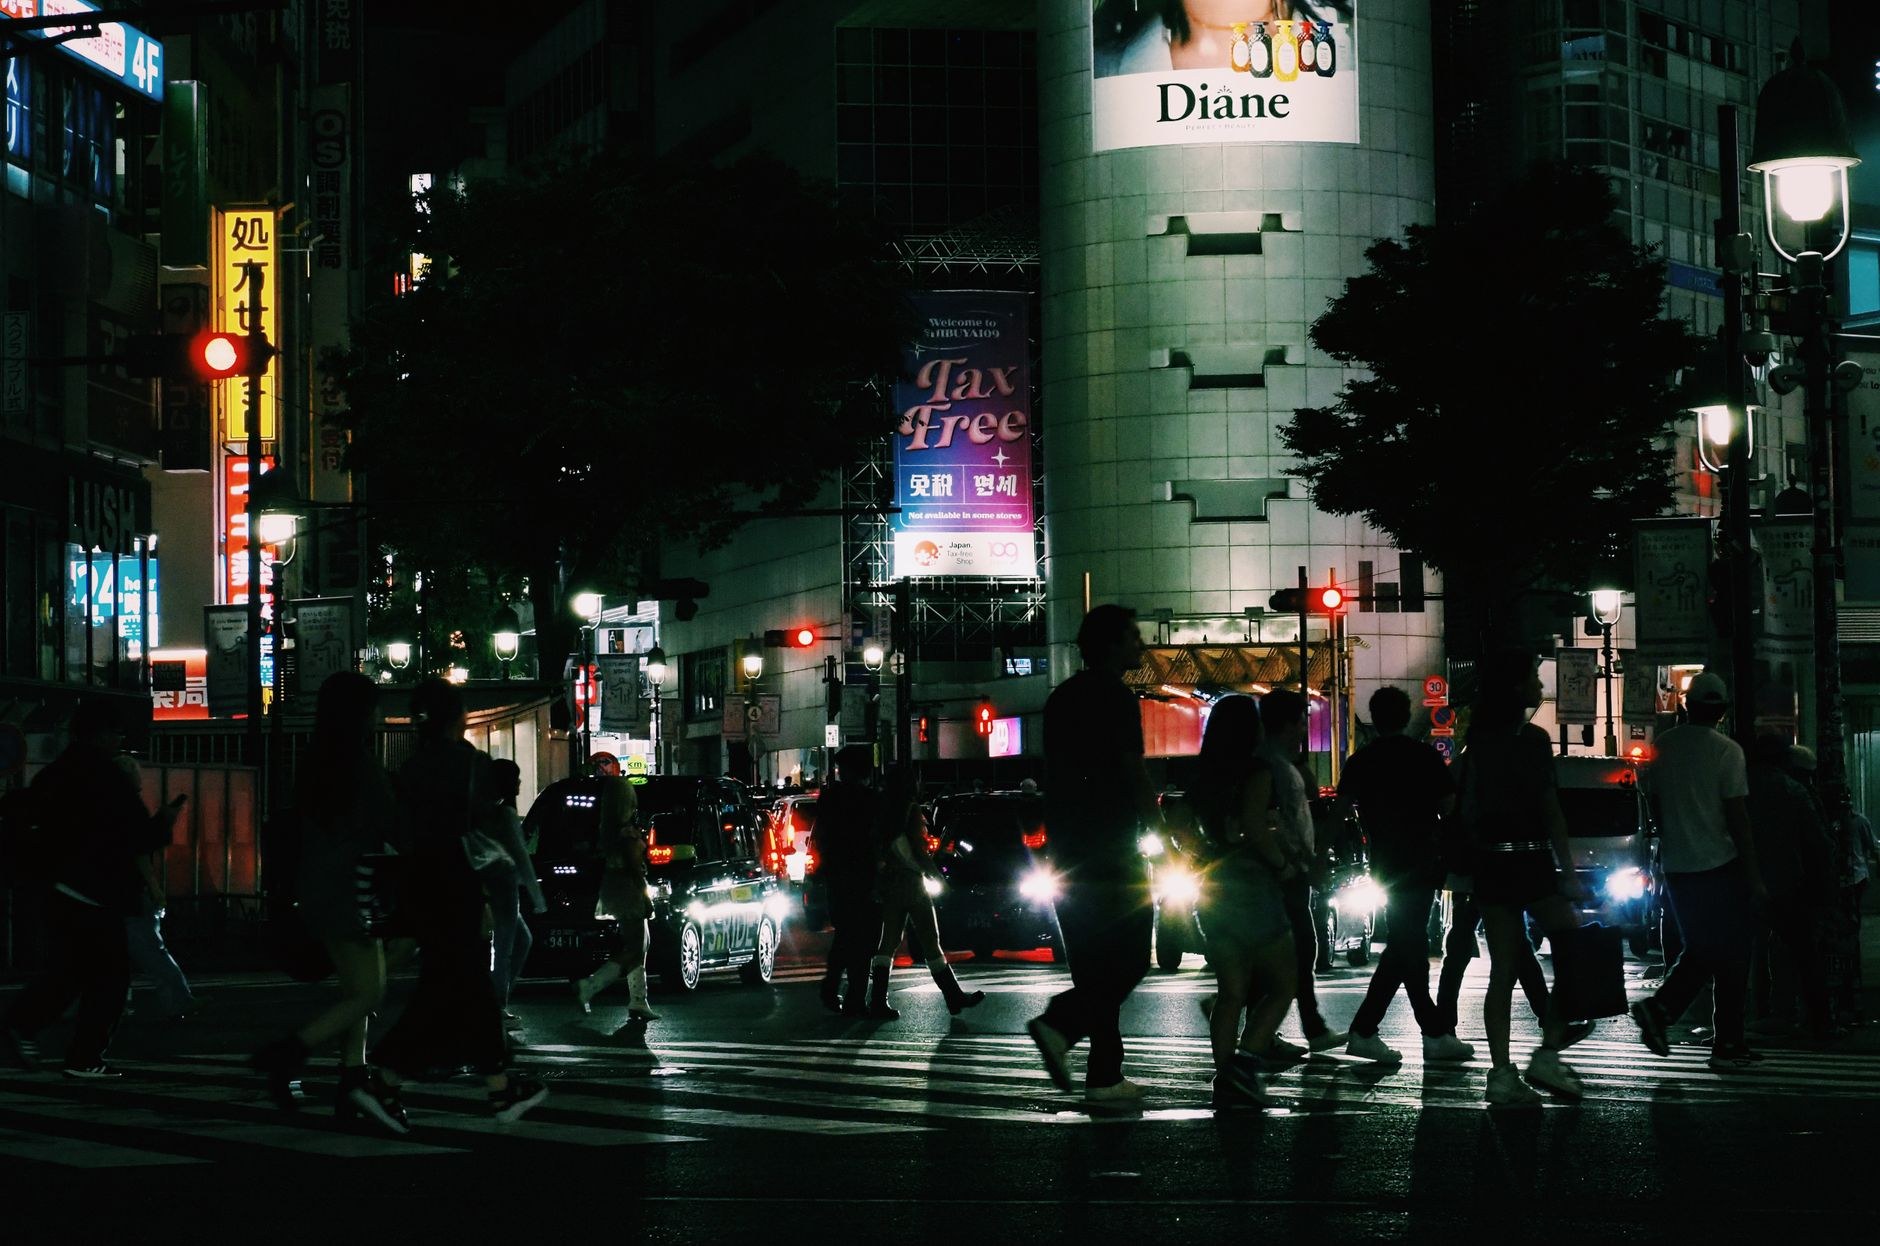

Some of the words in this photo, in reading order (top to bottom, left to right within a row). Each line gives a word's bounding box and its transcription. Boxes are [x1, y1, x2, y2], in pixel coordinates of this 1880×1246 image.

[133, 36, 160, 95] 4F
[1156, 82, 1290, 123] Diane
[928, 318, 982, 327] Welcome
[985, 319, 997, 327] to
[917, 358, 1018, 403] Tax
[899, 403, 1028, 450] Free
[910, 474, 952, 497] 免税
[973, 474, 1017, 497] 면세
[908, 511, 923, 519] Not
[925, 511, 960, 519] available
[963, 511, 970, 519] in
[996, 511, 1022, 519] stores
[957, 557, 974, 565] Shop
[125, 576, 157, 591] hor
[1429, 682, 1442, 692] 30
[751, 708, 758, 719] 4
